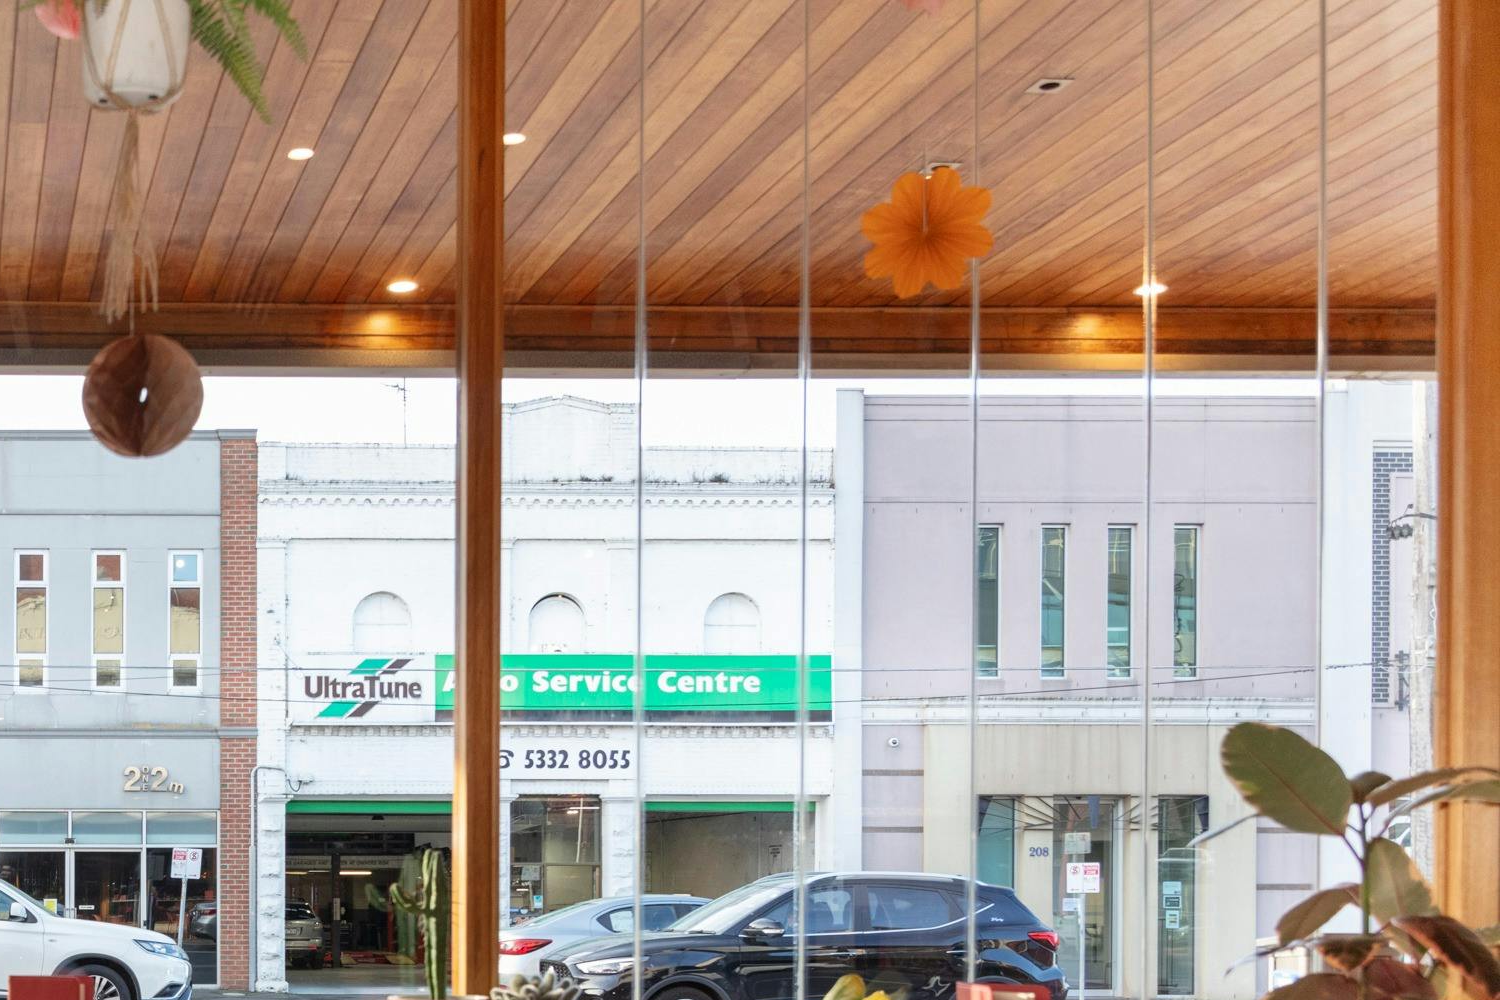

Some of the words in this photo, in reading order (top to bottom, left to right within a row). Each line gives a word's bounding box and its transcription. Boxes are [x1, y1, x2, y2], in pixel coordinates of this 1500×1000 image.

[304, 675, 422, 699] UltraTune
[442, 671, 519, 692] Ao
[657, 671, 761, 693] Centre
[524, 749, 569, 769] 5332
[578, 749, 631, 769] 8055
[1029, 846, 1049, 857] 208
